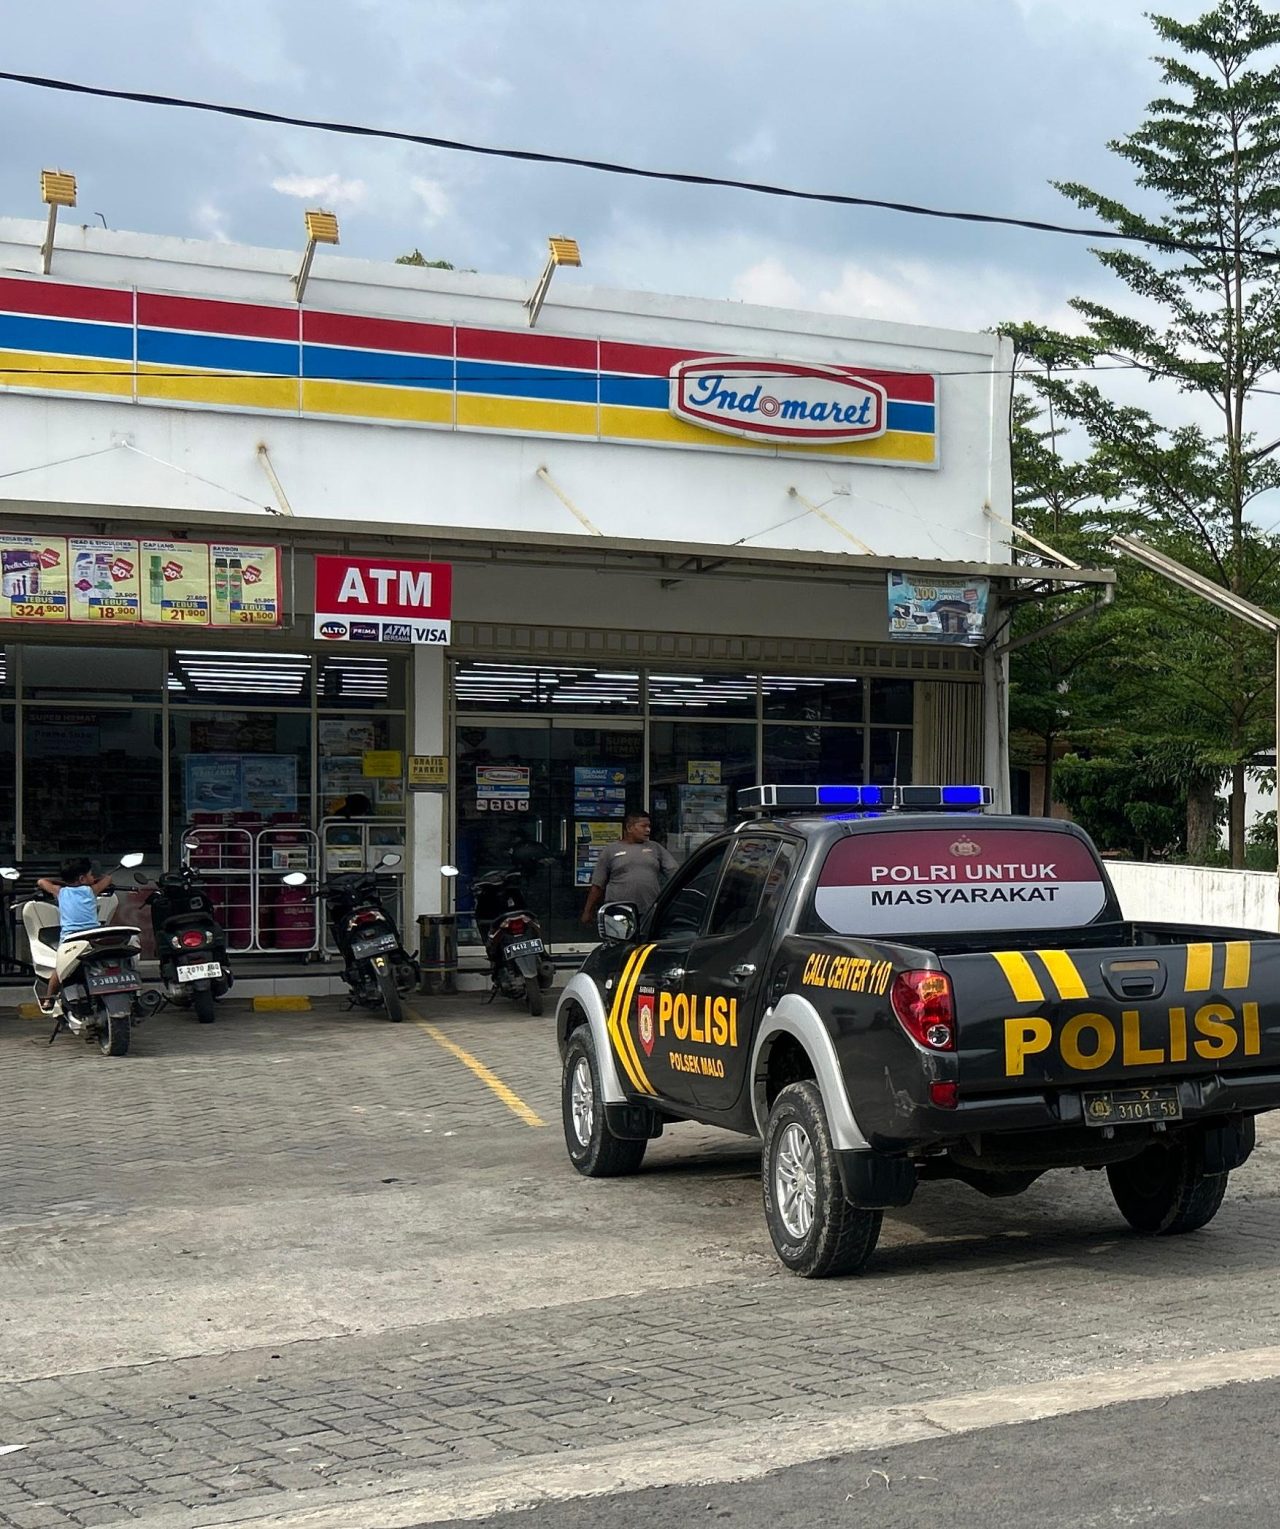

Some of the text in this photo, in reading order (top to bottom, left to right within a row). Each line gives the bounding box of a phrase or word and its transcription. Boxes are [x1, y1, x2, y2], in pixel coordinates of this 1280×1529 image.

[689, 375, 871, 424] Indomaret
[25, 596, 53, 604] TEBUS
[337, 567, 432, 607] ATM
[384, 625, 410, 636] ATM
[413, 627, 447, 642] VISA
[871, 863, 1058, 882] POLRI UNTUK
[871, 887, 1059, 906] MASYARAKAT
[802, 953, 893, 996] CALL CENTER 110
[659, 991, 738, 1048] POLISI
[1004, 1001, 1261, 1077] POLISI
[669, 1051, 725, 1079] POLSEK MALO
